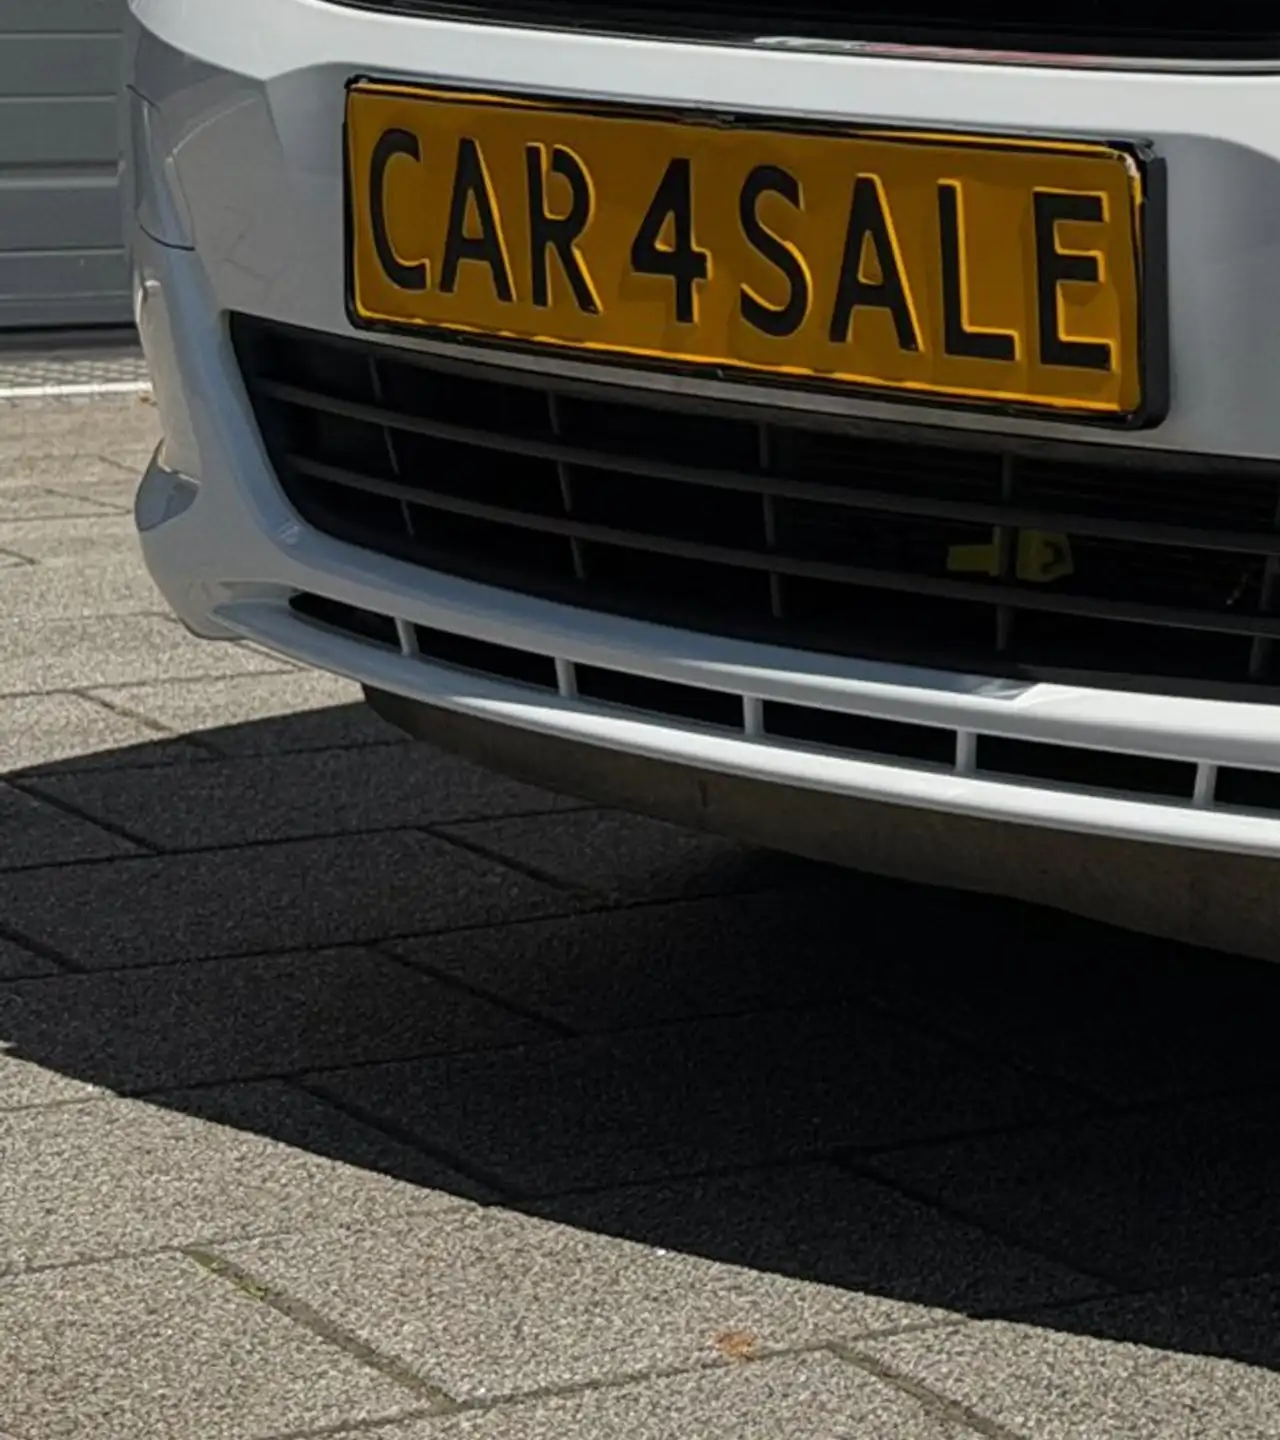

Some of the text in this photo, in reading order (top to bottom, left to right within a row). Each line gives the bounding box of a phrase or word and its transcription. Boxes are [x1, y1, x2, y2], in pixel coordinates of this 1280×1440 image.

[369, 128, 1114, 373] CAR 4 SALE
